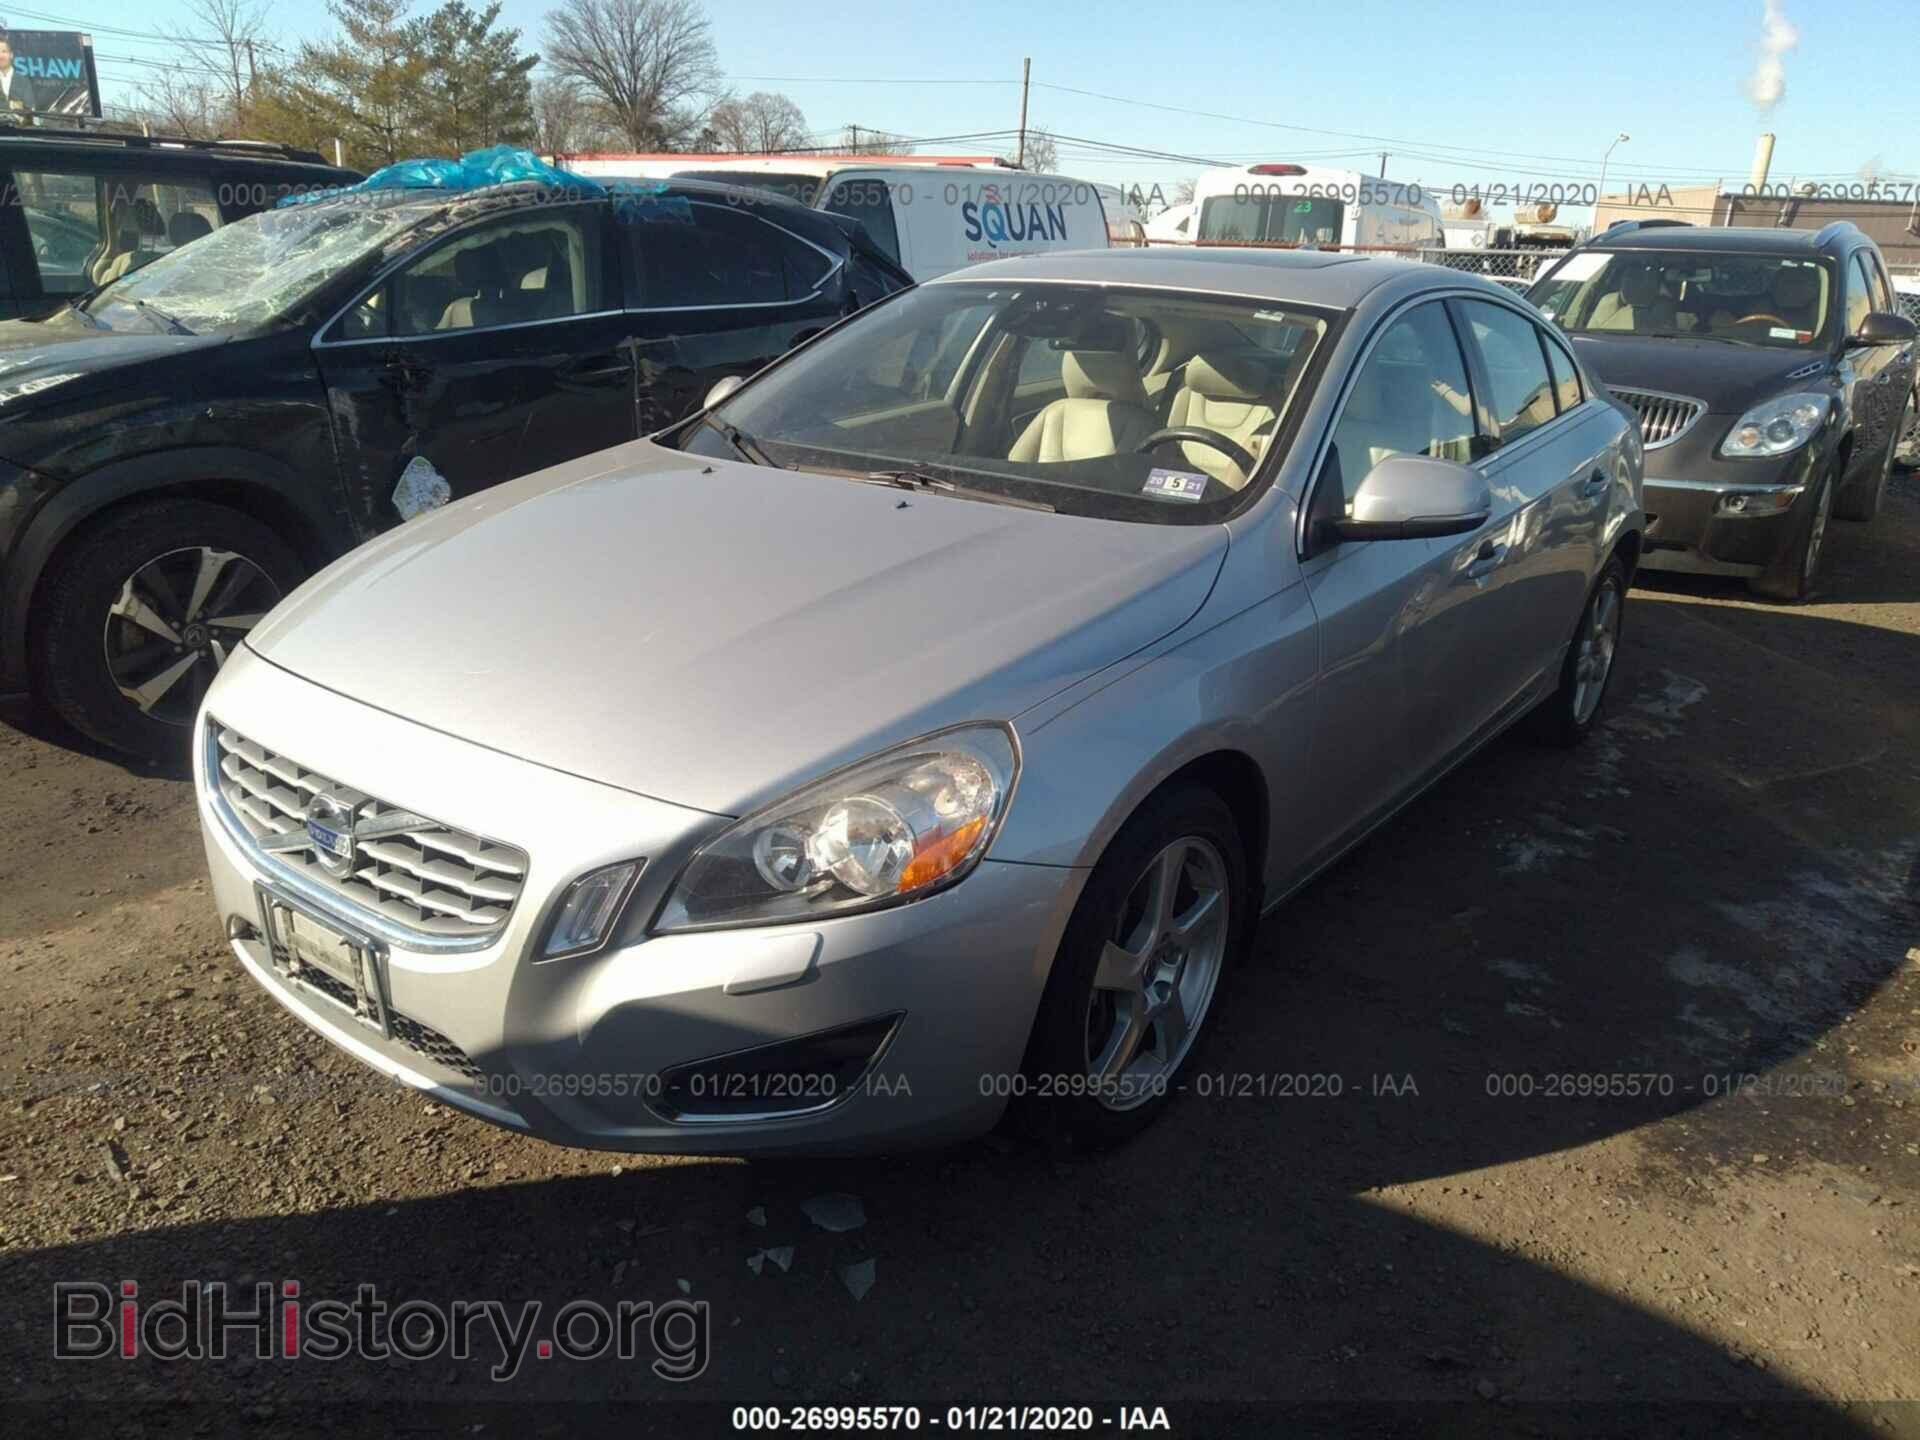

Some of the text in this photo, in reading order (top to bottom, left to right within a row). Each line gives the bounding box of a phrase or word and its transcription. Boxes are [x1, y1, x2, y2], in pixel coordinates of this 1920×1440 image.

[14, 55, 81, 79] SHAW
[1294, 201, 1313, 213] 23
[962, 200, 1068, 248] SQUAN
[1171, 478, 1181, 488] 5
